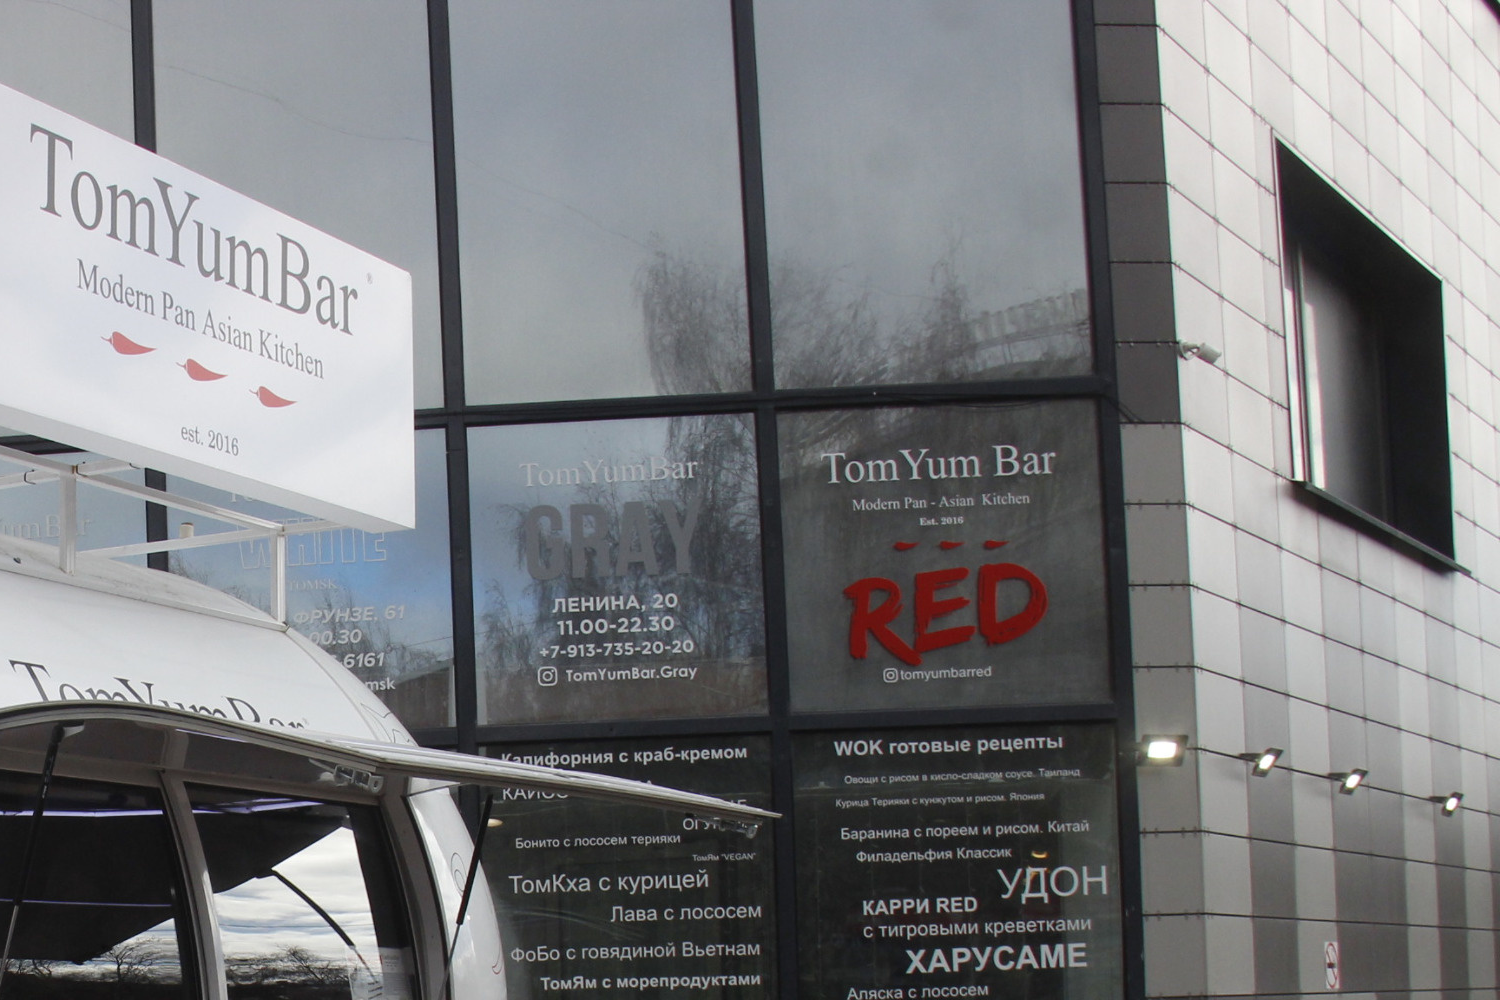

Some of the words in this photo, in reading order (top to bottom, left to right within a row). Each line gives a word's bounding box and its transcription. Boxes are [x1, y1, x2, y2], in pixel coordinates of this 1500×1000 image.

[30, 123, 358, 336] TomYumBar
[77, 258, 155, 315] Modern
[162, 291, 196, 332] Pan
[202, 309, 252, 353] Asian
[258, 328, 324, 380] Kitchen
[180, 425, 204, 447] est.
[208, 432, 239, 457] 2016
[993, 445, 1056, 477] Bar
[519, 456, 698, 487] TomYumBar
[852, 497, 901, 511] Modern
[904, 496, 927, 509] Pan
[939, 495, 975, 507] Asian
[982, 492, 1030, 505] Kitchen
[919, 516, 938, 526] Est.
[941, 516, 964, 525] 2016
[525, 500, 700, 580] GRAY
[385, 604, 405, 619] 61
[552, 595, 646, 613] ЛЕНИНА,
[653, 593, 678, 609] 20
[843, 562, 1048, 666] RED
[557, 615, 675, 636] 11.00-22.30
[539, 640, 694, 659] +7-913-735-20-20
[566, 665, 697, 683] TomYumBar.Gray
[900, 666, 993, 682] tomyumbarred
[834, 740, 884, 756] WOK
[889, 739, 971, 754] готовые
[977, 736, 1063, 754] рецепты
[619, 752, 628, 762] с
[634, 748, 747, 769] краб-кремом
[844, 775, 878, 784] Овощи
[889, 774, 919, 783] рисом
[922, 774, 928, 782] в
[835, 798, 869, 808] Курица
[1009, 792, 1045, 801] Япония
[840, 826, 909, 842] Баранина
[914, 828, 922, 838] с
[926, 826, 978, 840] пореем
[983, 825, 991, 835] и
[996, 822, 1043, 836] рисом.
[1048, 819, 1090, 833] Китай
[515, 838, 560, 849] Бонито
[564, 839, 570, 847] с
[574, 836, 627, 847] лососем
[631, 834, 681, 846] терияки
[856, 849, 952, 863] Филадельфия
[957, 847, 1012, 860] Классик
[509, 873, 591, 894] ТомКха
[599, 877, 611, 891] с
[618, 870, 710, 895] курицей
[997, 865, 1109, 904] УДОН
[611, 906, 658, 922] Лава
[664, 909, 674, 920] с
[679, 904, 762, 920] лососем
[862, 899, 930, 916] КАРРИ
[936, 896, 979, 913] RED
[863, 926, 873, 938] с
[879, 922, 979, 940] тигровыми
[985, 917, 1092, 938] креветками
[511, 945, 560, 963] ФоБо
[566, 948, 576, 959] с
[582, 942, 676, 960] говядиной
[682, 941, 761, 958] Вьетнам
[906, 942, 1088, 974] ХАРУСАМЕ
[541, 975, 597, 991] ТомЯм
[603, 978, 612, 989] с
[616, 973, 762, 992] морепродуктами
[847, 986, 903, 1000] Аляска
[908, 989, 917, 999] с
[922, 984, 989, 998] лососем
